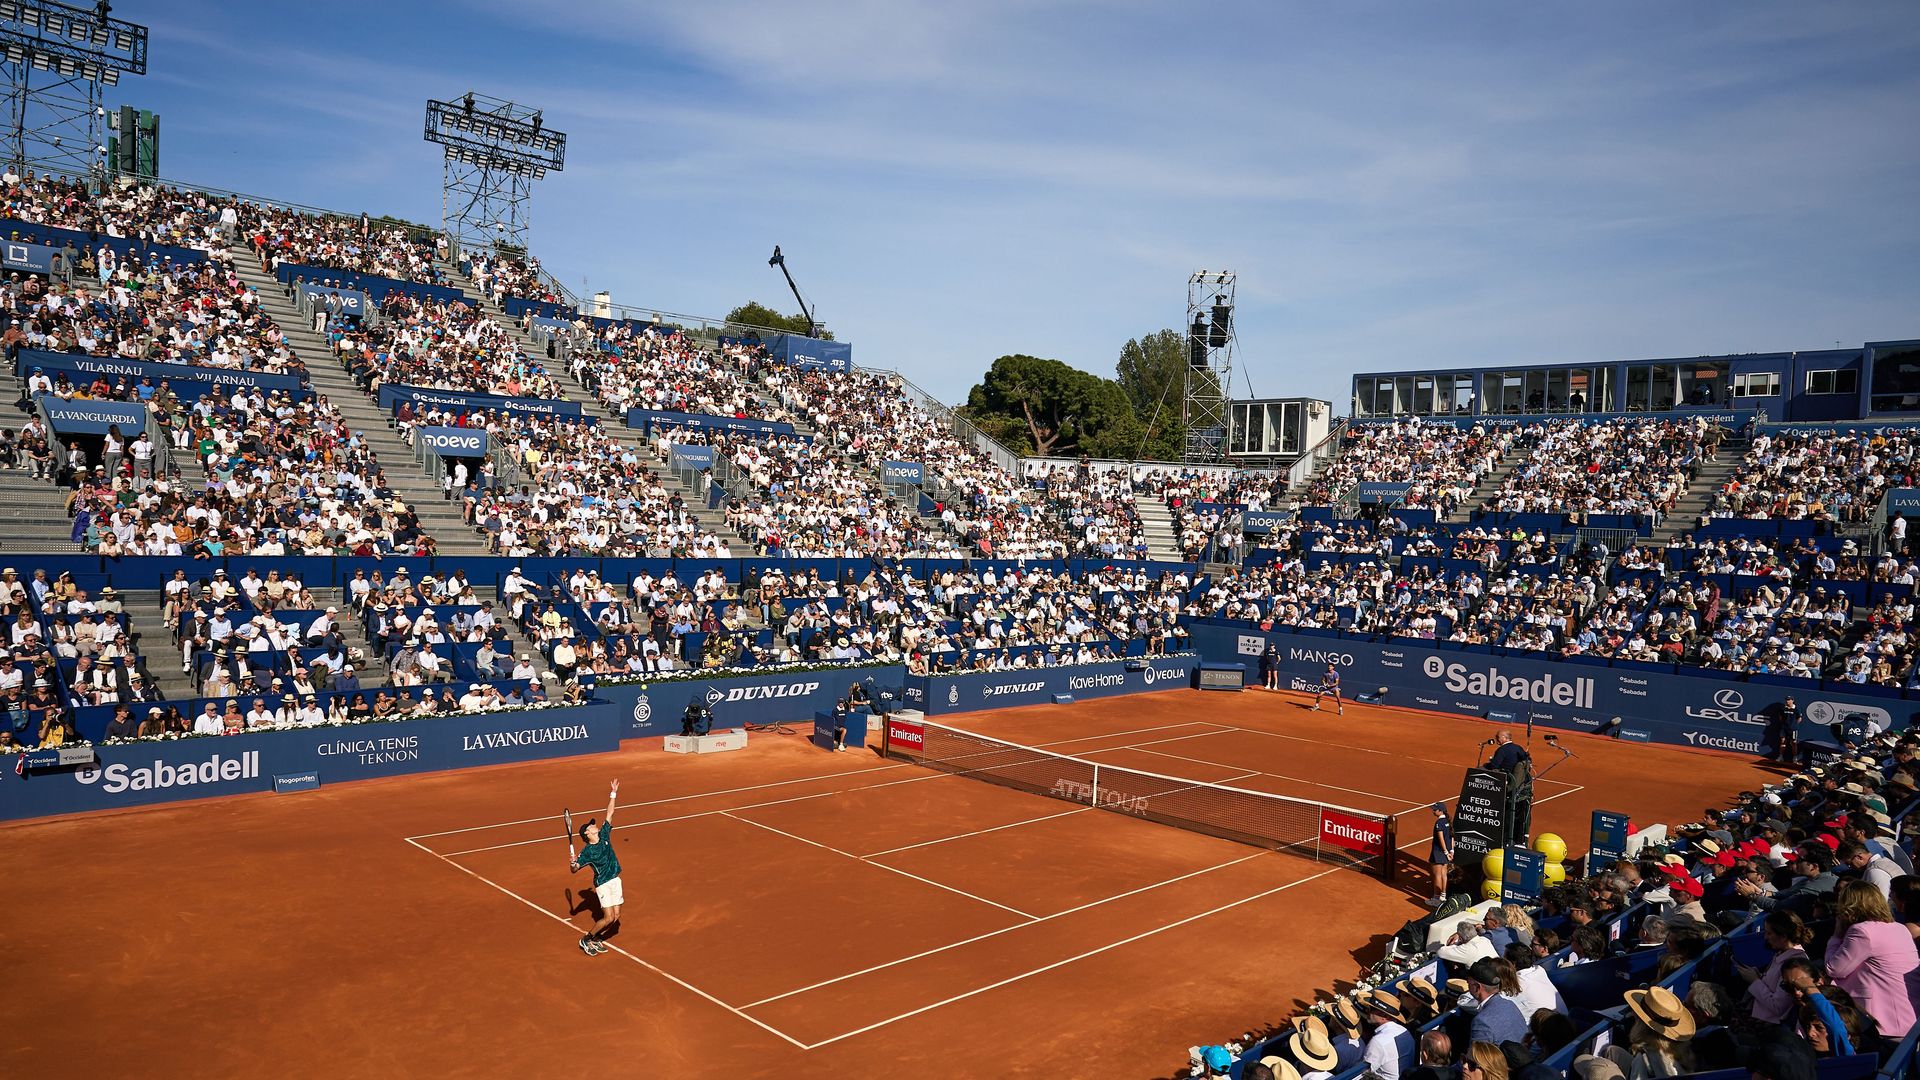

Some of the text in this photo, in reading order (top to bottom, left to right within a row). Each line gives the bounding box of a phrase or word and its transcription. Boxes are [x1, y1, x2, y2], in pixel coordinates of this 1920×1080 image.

[76, 361, 142, 376] VILARNAU
[51, 411, 137, 424] LA VANGUARDIA
[1791, 428, 1830, 437] Occiden
[424, 434, 479, 449] moeve
[1291, 647, 1354, 667] MANGO
[1069, 673, 1124, 690] Kave Home
[1156, 668, 1185, 680] VEOLIA
[1215, 672, 1240, 680] TEKNON
[1623, 677, 1648, 686] Sabadell
[725, 682, 820, 702] DUNLOP
[993, 681, 1045, 695] DUNLOP
[1445, 663, 1595, 709] Sabadell
[1622, 688, 1647, 697] Sabadell
[1576, 717, 1600, 726] Sabadell
[1685, 706, 1771, 726] LEXUS
[463, 724, 589, 751] LA VANGUARDIA
[891, 727, 923, 743] Emirates
[318, 735, 418, 756] CLÍNICA TENIS
[715, 740, 727, 748] rtve
[1698, 733, 1760, 753] Occident
[359, 749, 418, 765] TEKNON
[102, 750, 259, 794] Sabadell
[278, 775, 316, 785] Flogoprofen
[1468, 781, 1502, 792] PRO PLAN
[1049, 778, 1149, 816] ATP TOUR
[1470, 796, 1491, 806] FEED
[1461, 804, 1500, 818] YOUR PET
[1458, 812, 1501, 827] LIKE A PRO
[1324, 818, 1382, 846] Emirates
[1454, 841, 1492, 854] PRO PLA
